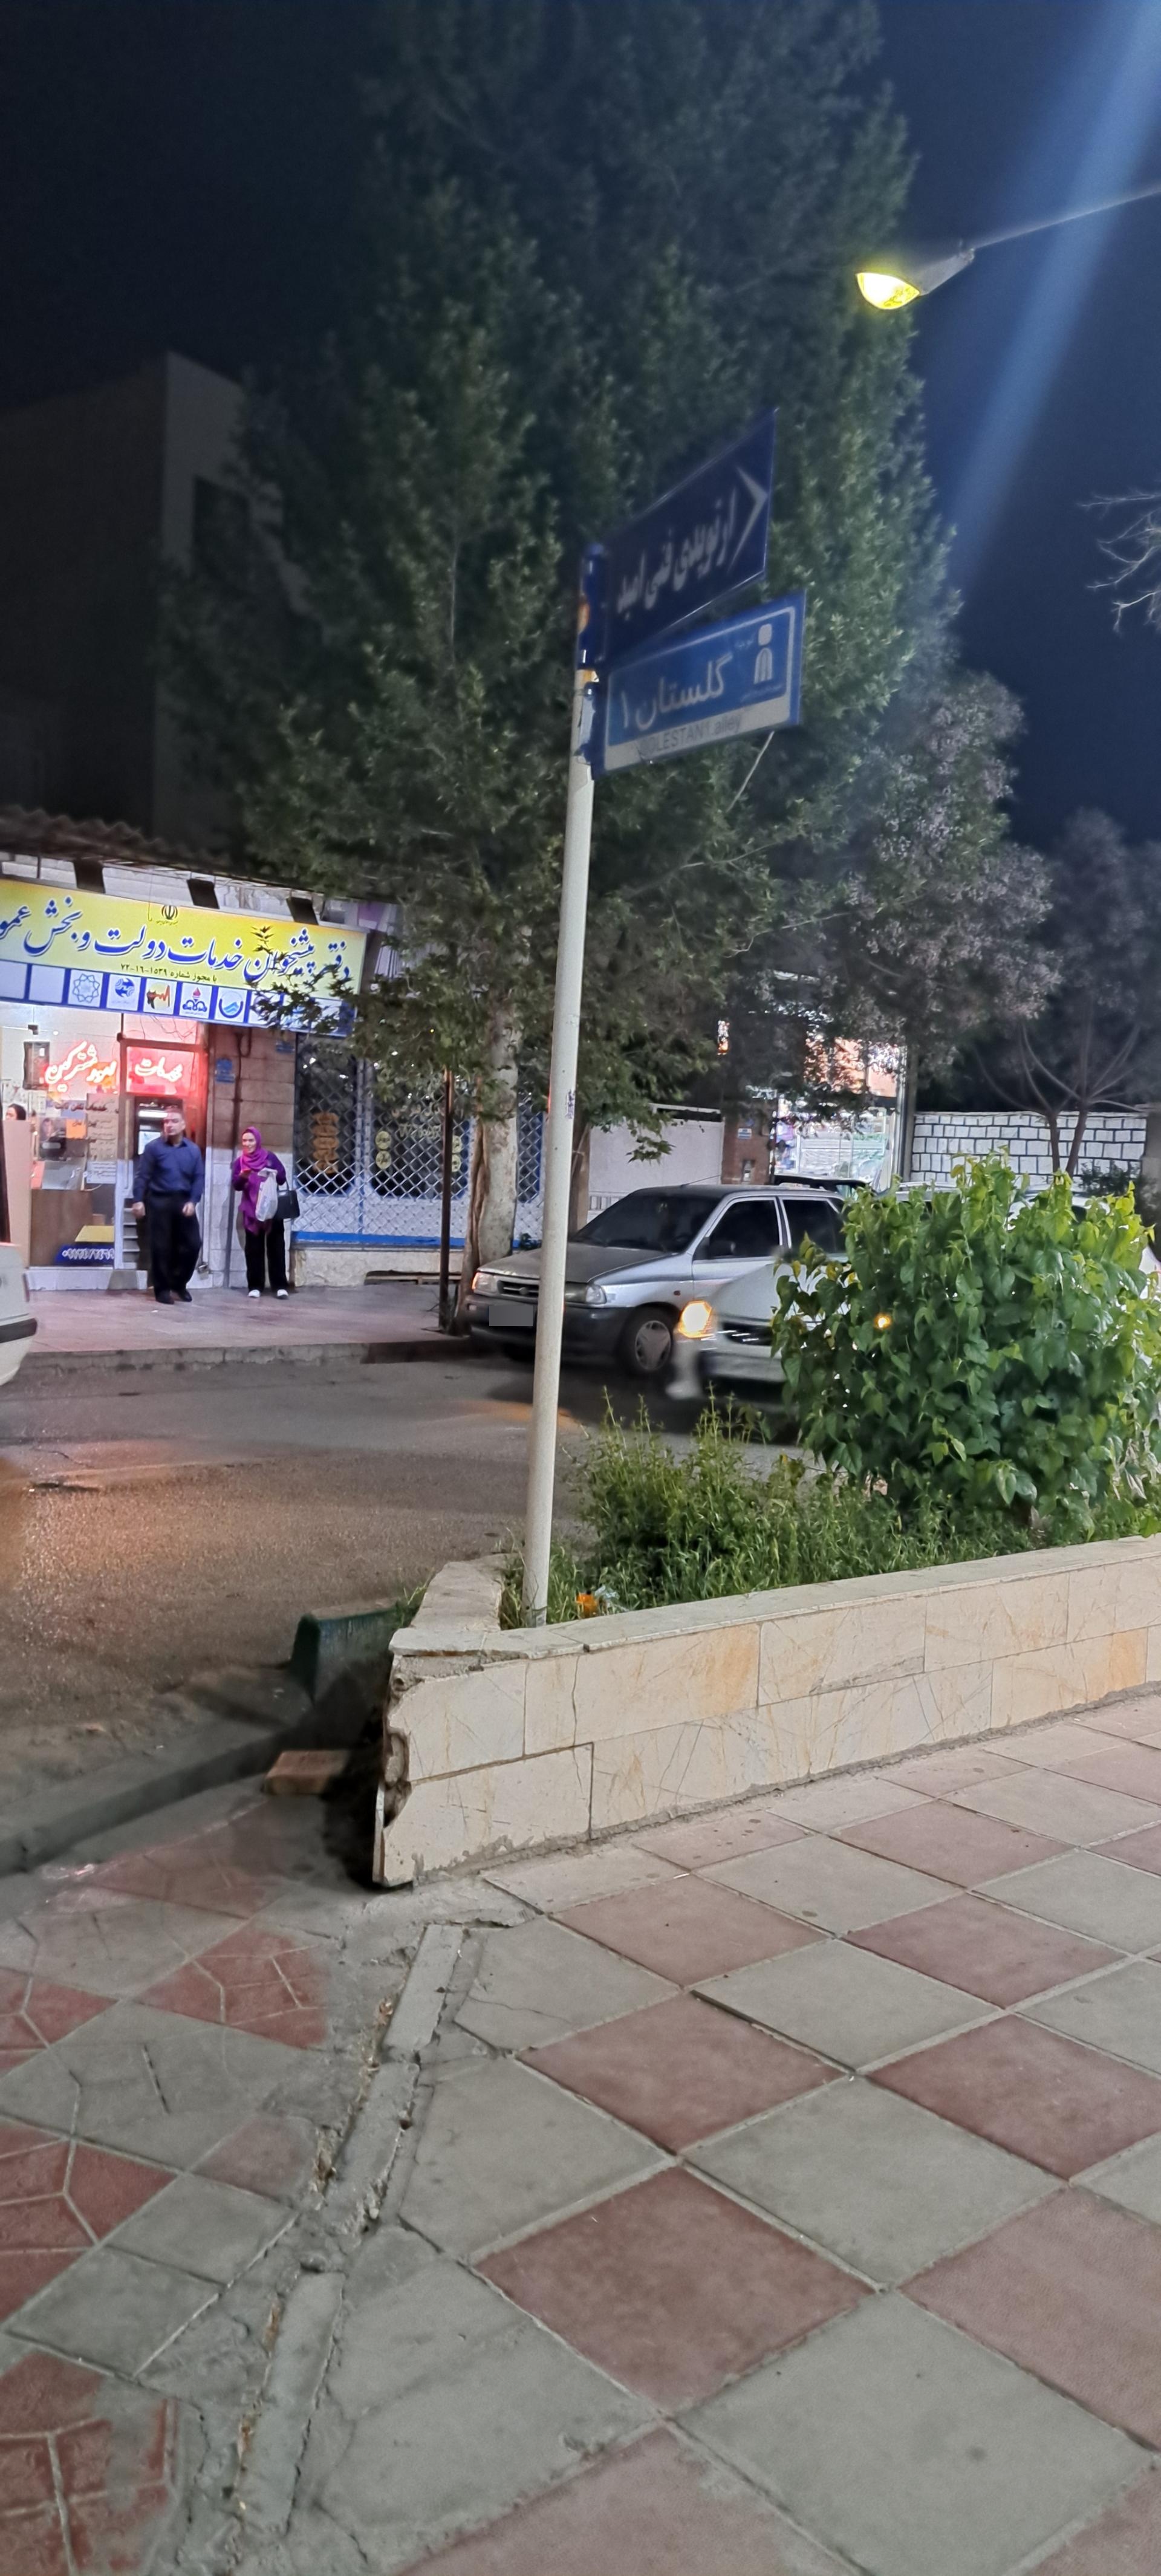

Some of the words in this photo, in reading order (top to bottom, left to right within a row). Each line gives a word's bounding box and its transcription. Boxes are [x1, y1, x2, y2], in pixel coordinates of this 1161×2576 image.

[635, 651, 734, 731] گلستان
[23, 896, 82, 956] بخش
[77, 931, 91, 951] و
[94, 925, 166, 960] دولت
[167, 938, 244, 970] خدمات
[243, 928, 315, 982] پیشخوان
[307, 940, 351, 985] دفتر
[170, 970, 190, 978] شماره
[192, 972, 210, 983] مجوز
